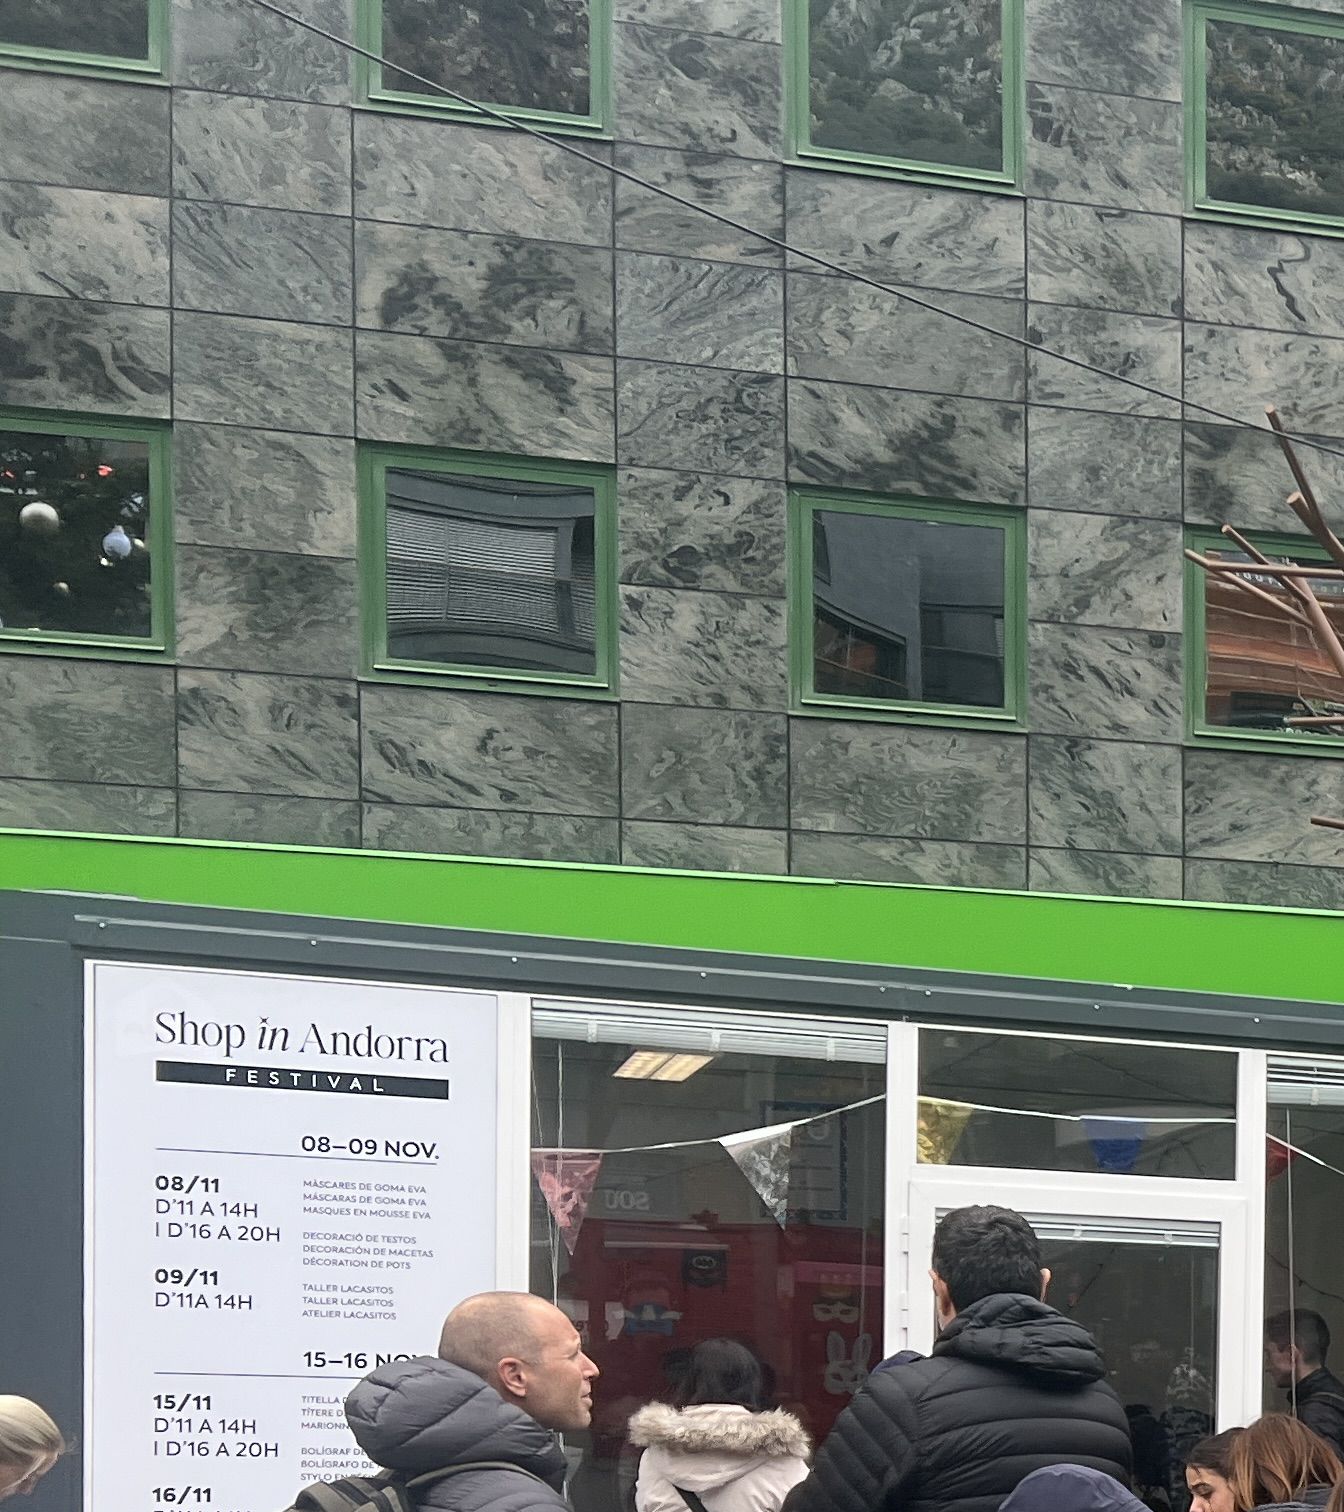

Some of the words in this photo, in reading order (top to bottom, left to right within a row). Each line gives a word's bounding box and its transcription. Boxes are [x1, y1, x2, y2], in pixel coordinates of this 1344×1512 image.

[155, 1011, 245, 1058] Shop
[257, 1016, 290, 1051] in
[298, 1023, 449, 1063] Andorra
[225, 1068, 384, 1093] FESTIVAL
[301, 1135, 377, 1155] 08–09
[384, 1139, 440, 1160] NOV.
[155, 1175, 220, 1194] 08/11
[358, 1183, 372, 1191] DE
[374, 1184, 405, 1193] GOMA
[407, 1186, 427, 1194] EVA
[358, 1196, 372, 1204] DE
[374, 1197, 406, 1205] GOMA
[408, 1198, 427, 1206] EVA
[155, 1199, 194, 1216] D'11
[200, 1201, 215, 1217] A
[220, 1202, 258, 1218] 14H
[303, 1207, 351, 1216] MASQUES
[353, 1209, 367, 1217] EN
[369, 1210, 410, 1219] MOUSSE
[412, 1212, 431, 1220] EVA
[168, 1222, 211, 1239] D'16
[217, 1225, 232, 1240] A
[237, 1225, 281, 1242] 20H
[302, 1232, 363, 1242] DECORACIÓ
[365, 1234, 379, 1242] DE
[381, 1235, 417, 1244] TESTOS
[302, 1245, 371, 1255] DECORACIÓN
[373, 1248, 386, 1256] DE
[388, 1248, 434, 1258] MACETAS
[302, 1257, 368, 1268] DÉCORATION
[370, 1260, 384, 1268] DE
[386, 1261, 411, 1270] POTS
[154, 1268, 219, 1287] 09/11
[302, 1283, 338, 1292] TALLER
[340, 1285, 394, 1294] LACASITOS
[214, 1294, 253, 1310] 14H
[302, 1296, 338, 1305] TALLER
[340, 1298, 394, 1307] LACASITOS
[302, 1309, 341, 1318] ATELIER
[343, 1311, 397, 1320] LACASITOS
[303, 1351, 368, 1369] 15–16
[153, 1393, 212, 1412] 15/11
[301, 1395, 340, 1404] TITELLA
[154, 1417, 192, 1433] D'11
[198, 1418, 213, 1433] A
[218, 1419, 257, 1434] 14H
[301, 1422, 350, 1430] MARIONN
[166, 1441, 210, 1456] D'16
[215, 1442, 230, 1457] A
[236, 1442, 279, 1458] 20H
[361, 1461, 375, 1469] DE
[300, 1473, 332, 1481] STYLO
[152, 1486, 212, 1505] 16/11
